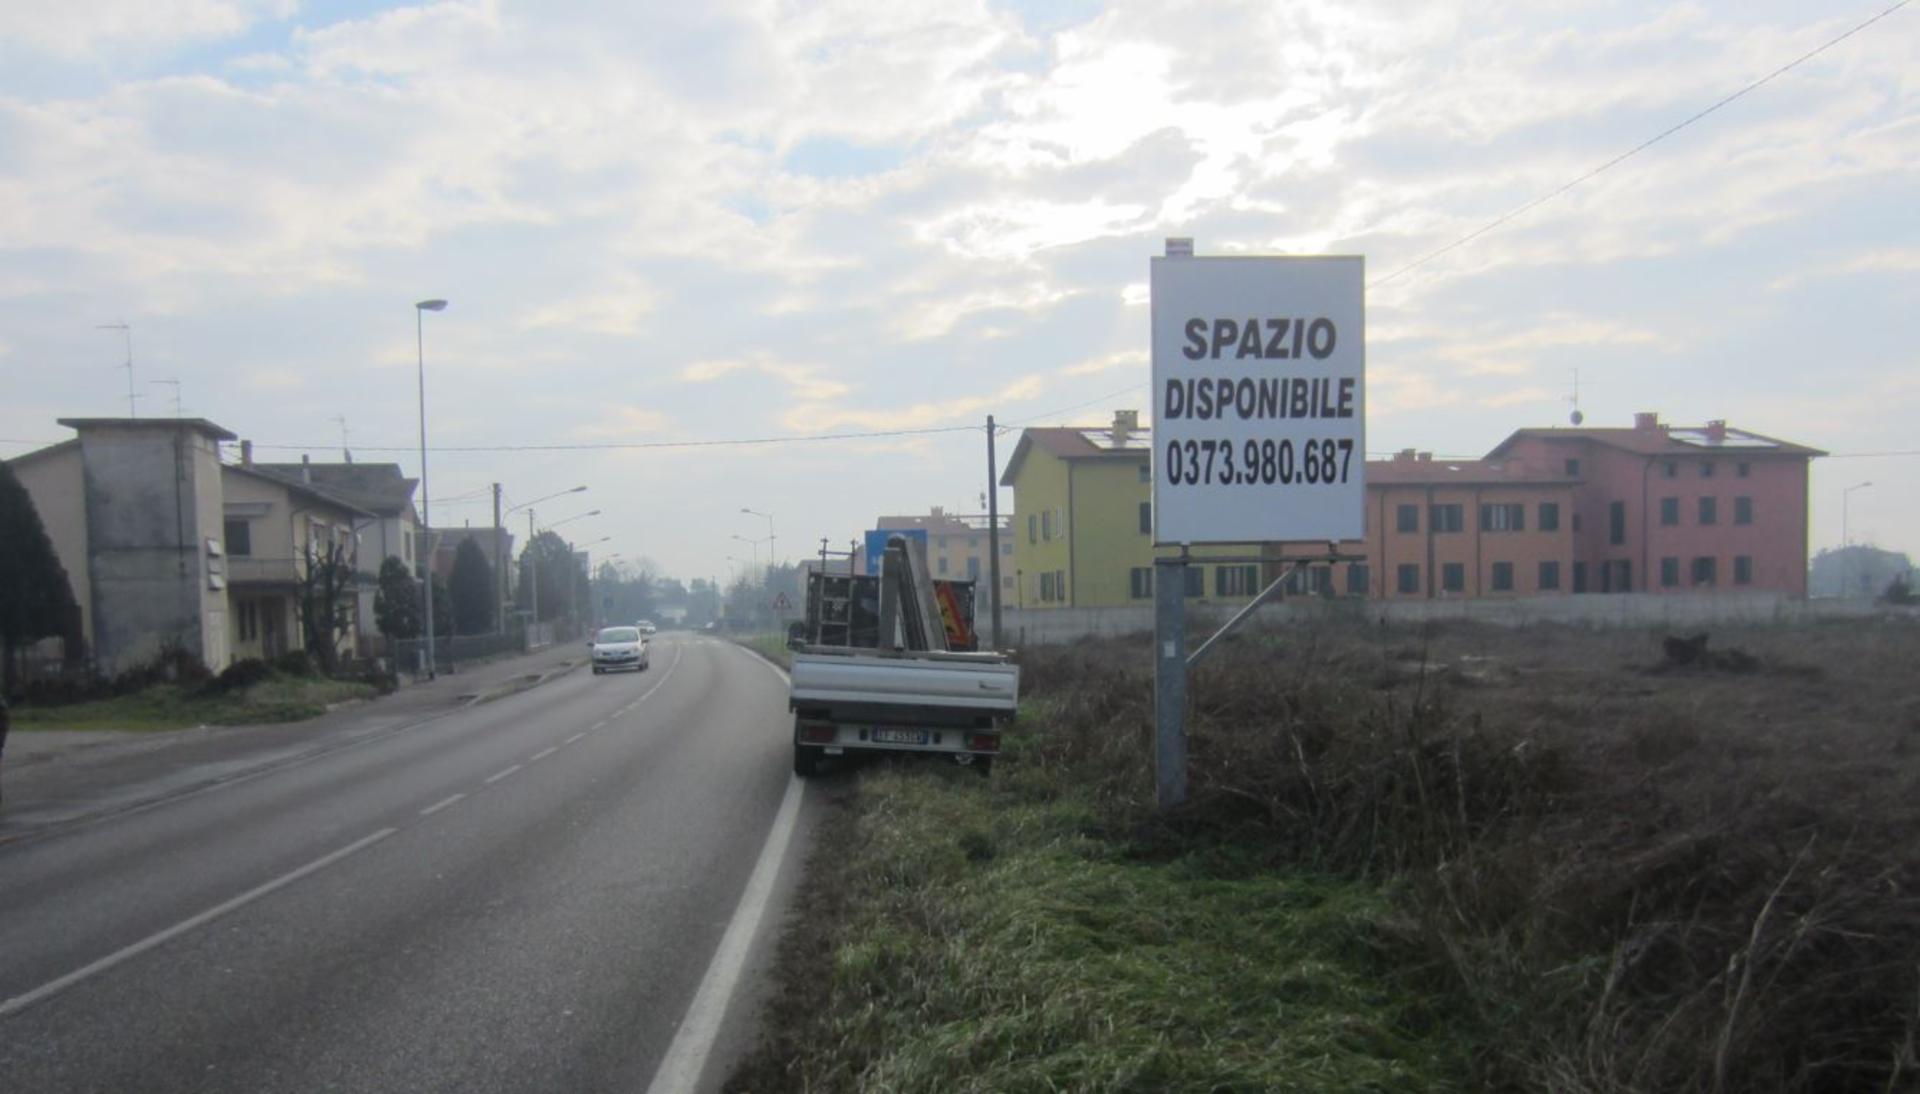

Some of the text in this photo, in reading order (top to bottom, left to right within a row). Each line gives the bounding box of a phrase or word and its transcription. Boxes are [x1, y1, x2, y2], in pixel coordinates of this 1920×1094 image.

[1183, 318, 1336, 360] SPAZIO
[1165, 377, 1355, 420] DISPONIBILE
[1167, 438, 1354, 486] 0373.980.687
